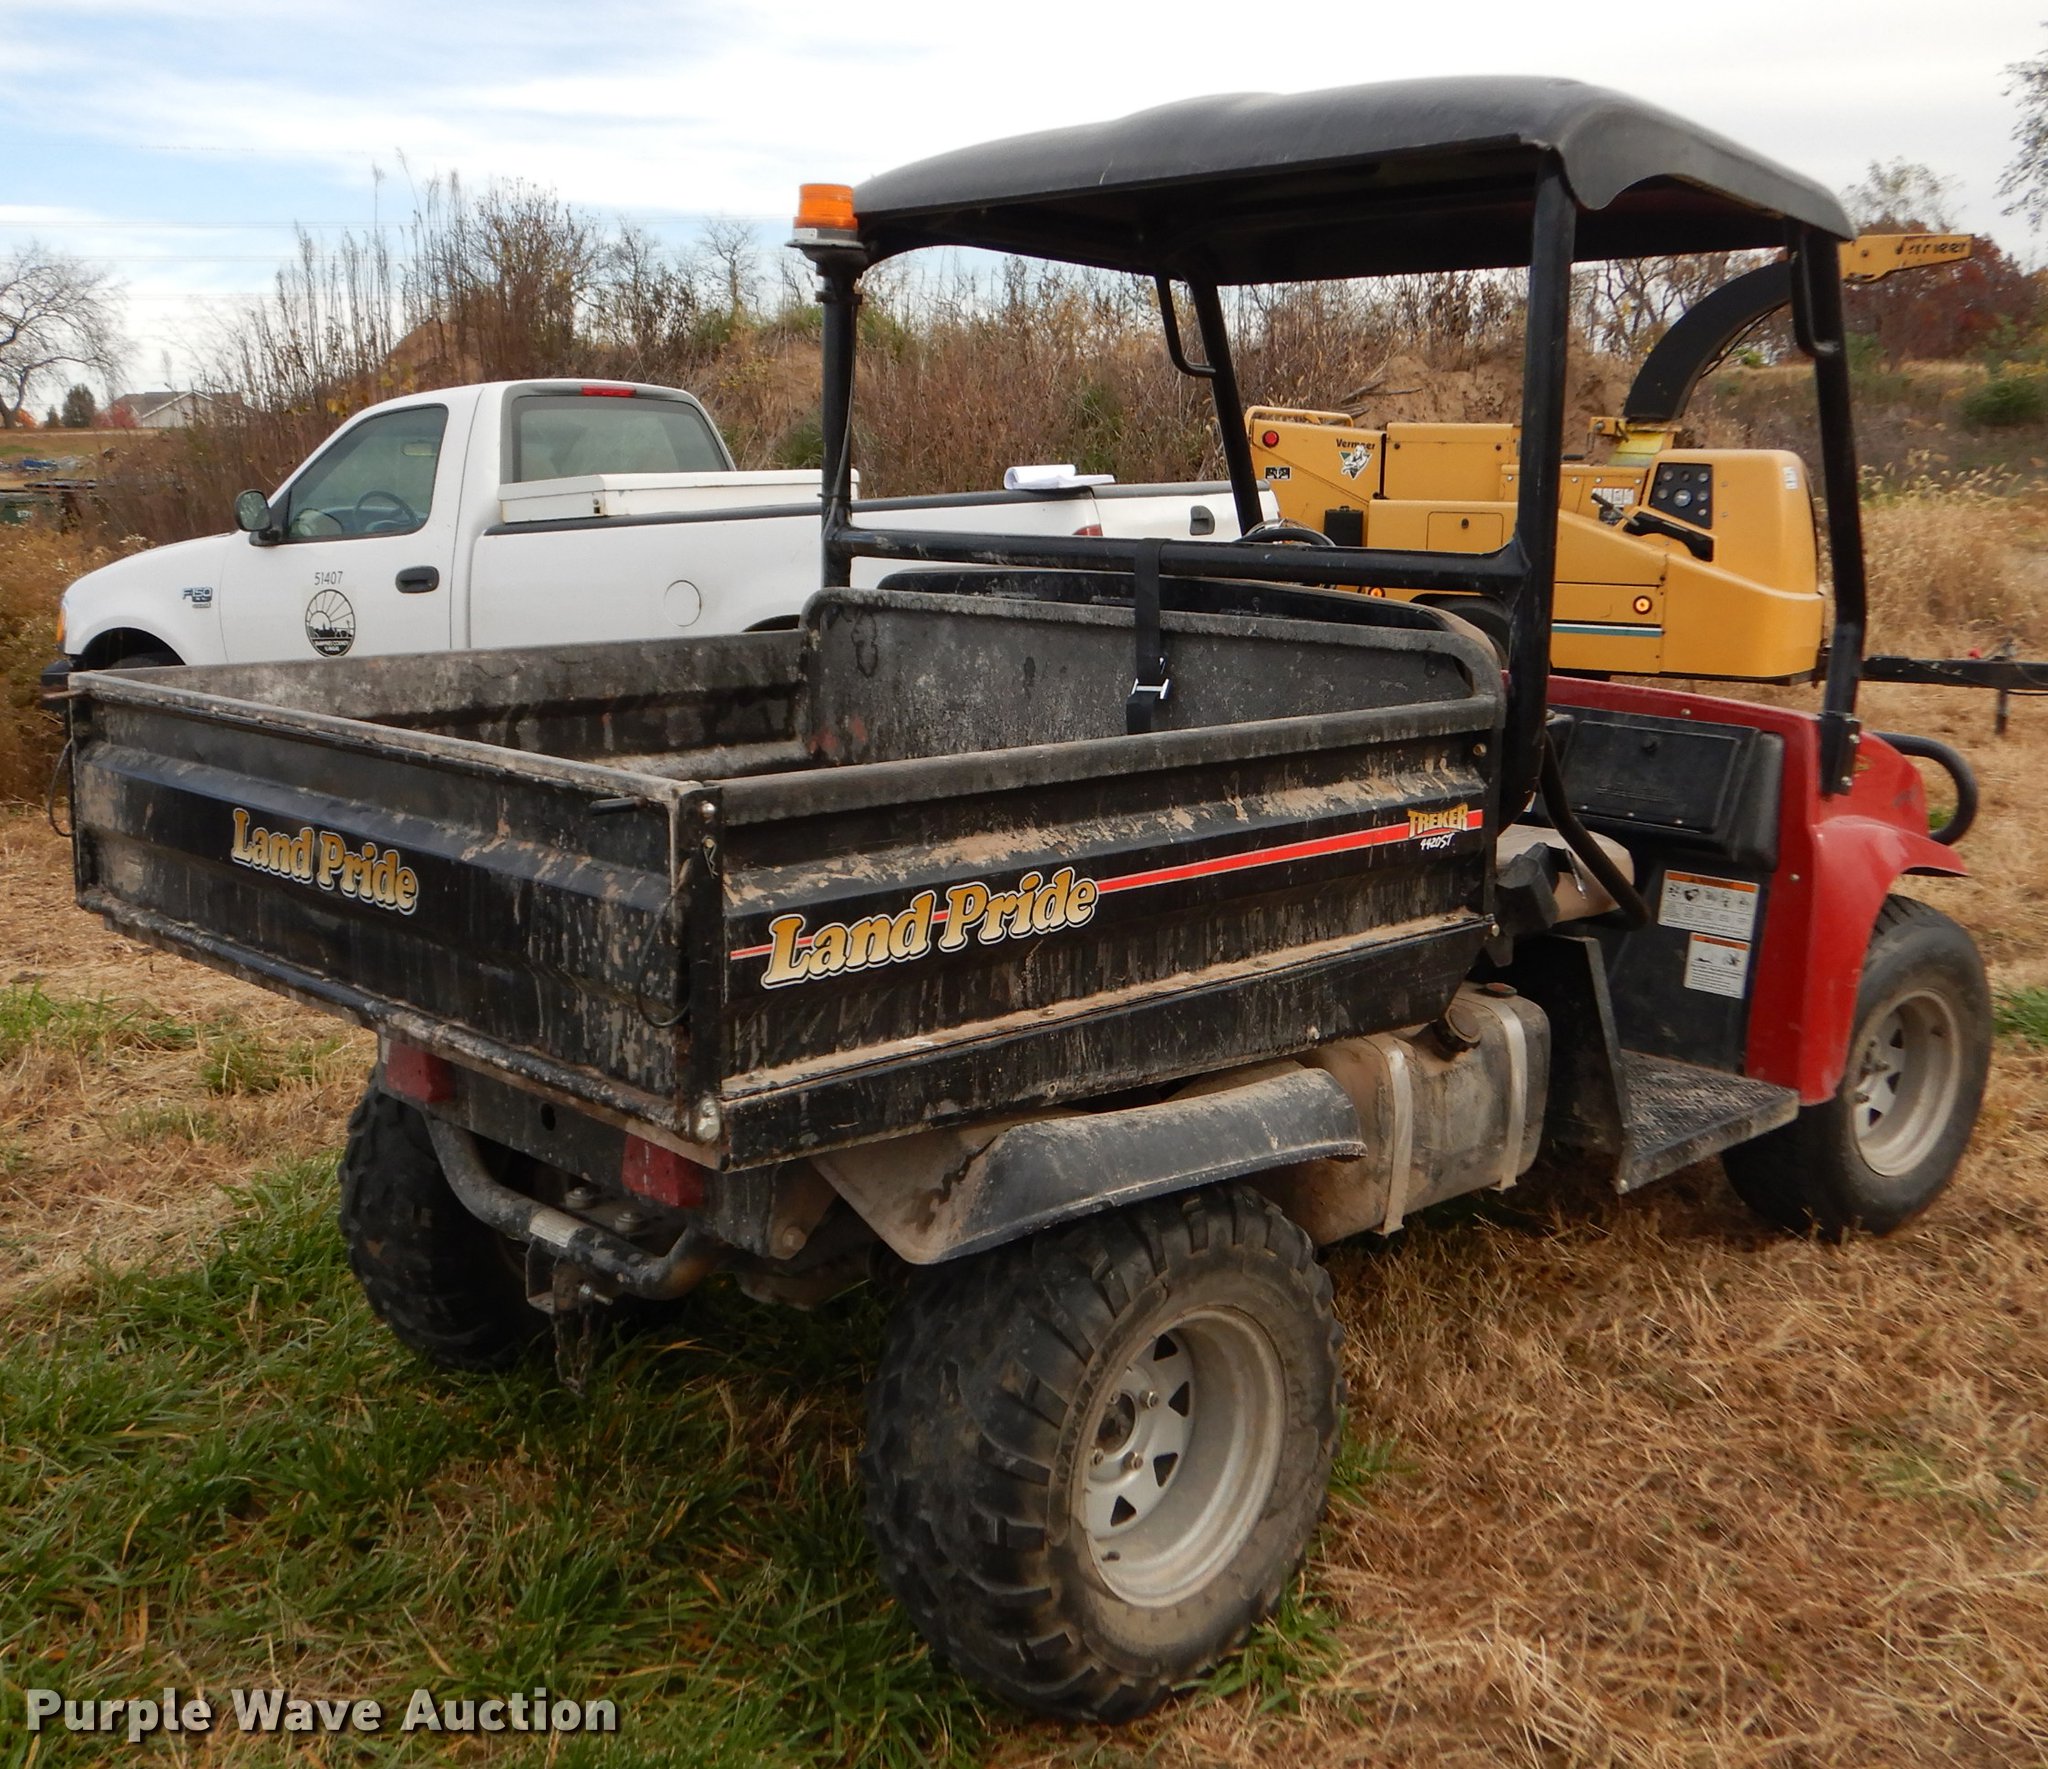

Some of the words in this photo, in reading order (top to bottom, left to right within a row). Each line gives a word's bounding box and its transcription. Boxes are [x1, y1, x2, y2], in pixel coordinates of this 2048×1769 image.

[314, 571, 344, 586] 51407
[1407, 803, 1468, 839] TREKER
[231, 808, 315, 884] Land
[317, 831, 419, 915] Pride
[761, 890, 936, 990] Land
[938, 866, 1100, 953] Pride
